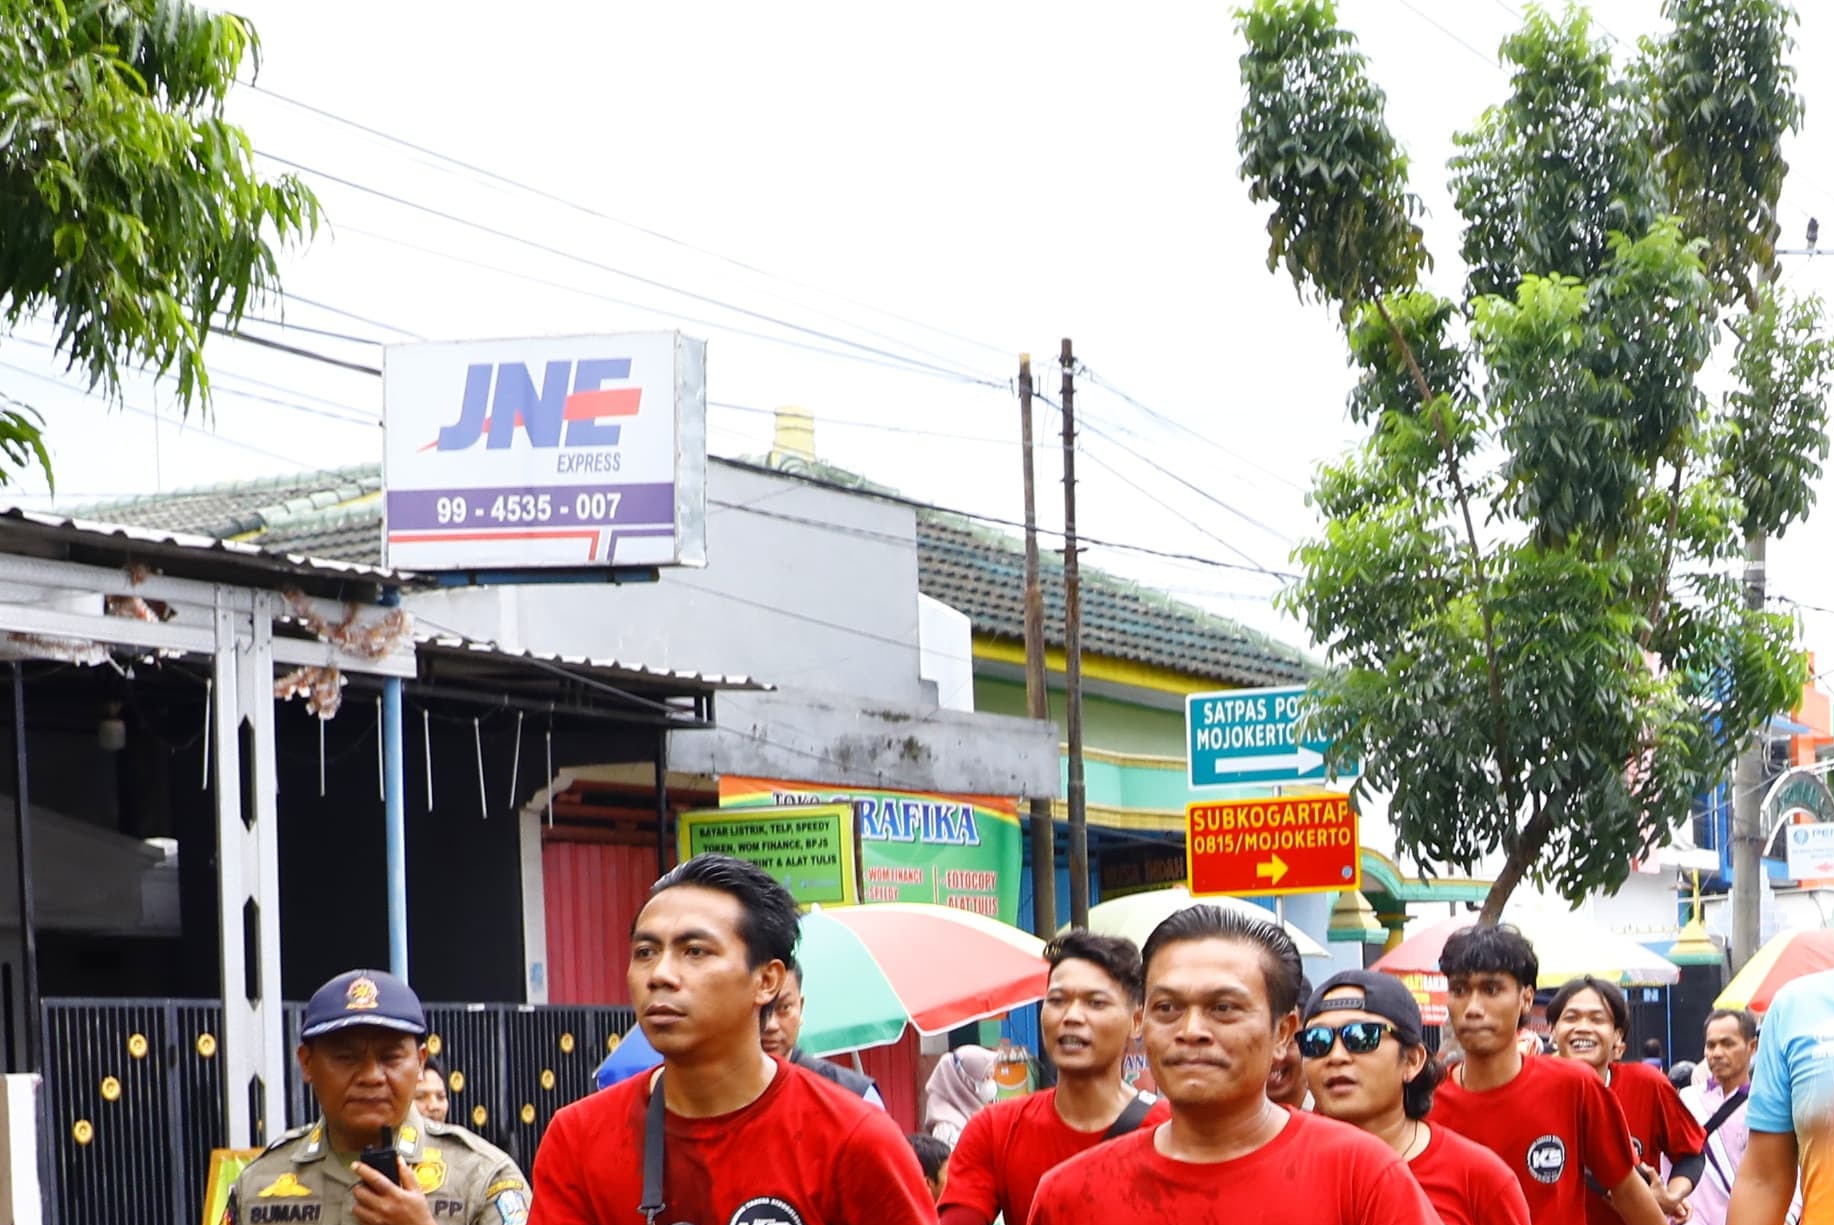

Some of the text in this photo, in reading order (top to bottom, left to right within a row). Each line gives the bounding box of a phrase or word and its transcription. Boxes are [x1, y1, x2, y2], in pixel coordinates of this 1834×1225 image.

[436, 357, 643, 452] JNE
[556, 451, 621, 473] EXPRESS
[437, 497, 467, 524] 99
[491, 495, 551, 522] 4535
[576, 492, 622, 519] 007
[1203, 698, 1267, 726] SATPAS
[796, 820, 830, 832] SPEEDY
[832, 797, 981, 846] RAFIKA
[1193, 801, 1348, 832] SUBKOGARTAP
[1193, 827, 1351, 856] 0815/MOJOKERTO
[785, 855, 807, 867] ALAT
[810, 854, 837, 866] TULIS
[250, 1205, 321, 1224] SUMARI
